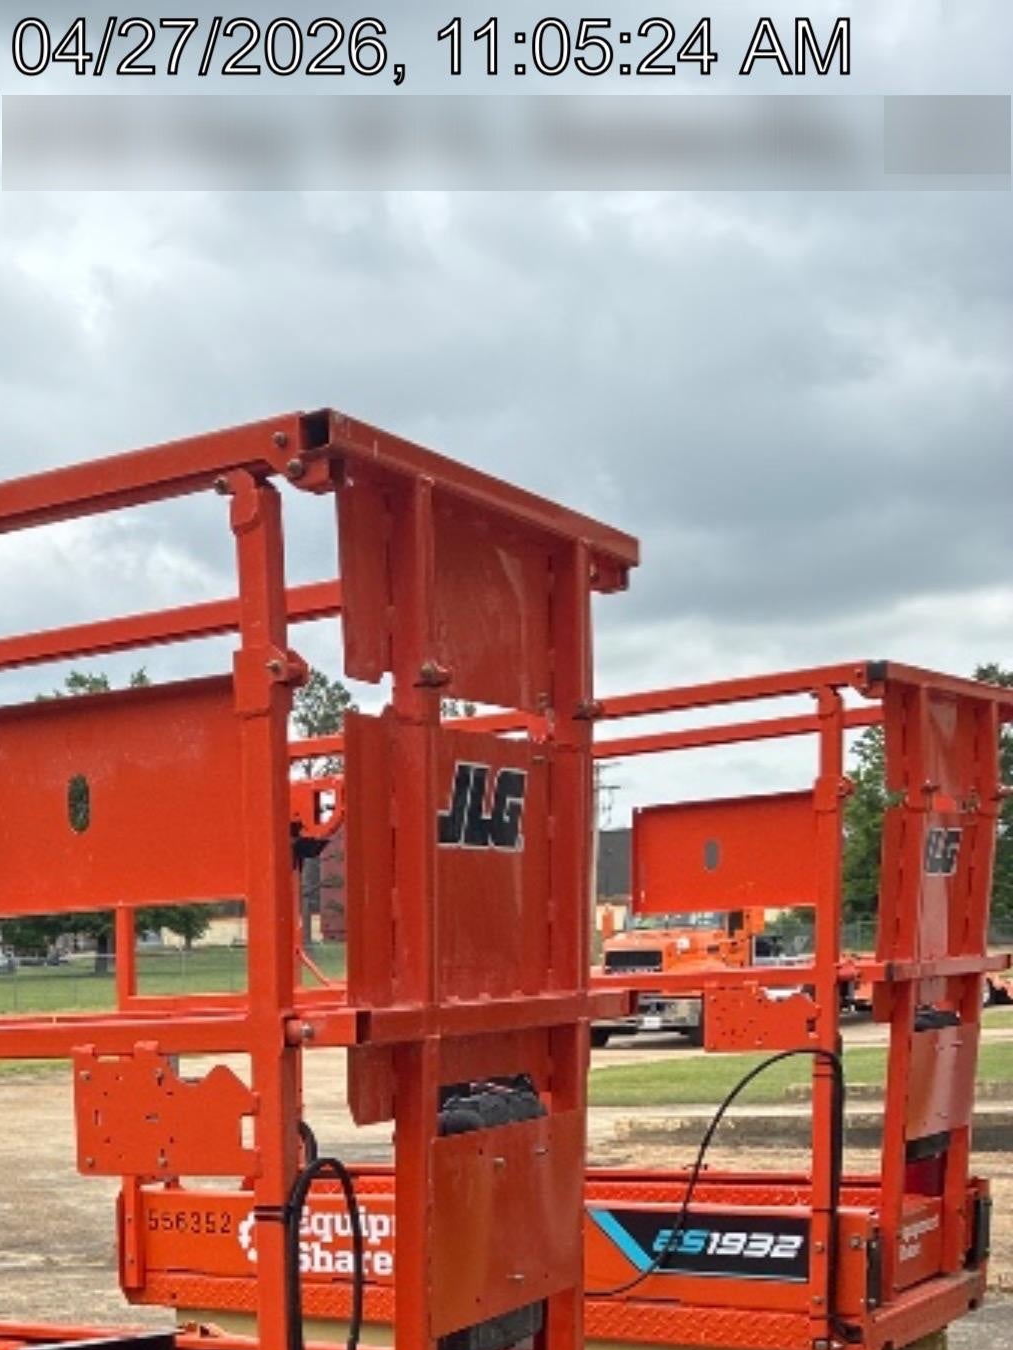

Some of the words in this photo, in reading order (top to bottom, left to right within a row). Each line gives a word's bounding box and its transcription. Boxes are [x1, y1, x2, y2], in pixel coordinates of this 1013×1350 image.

[437, 760, 527, 852] JLG
[148, 1208, 232, 1234] 556352
[652, 1229, 804, 1258] ES1932
